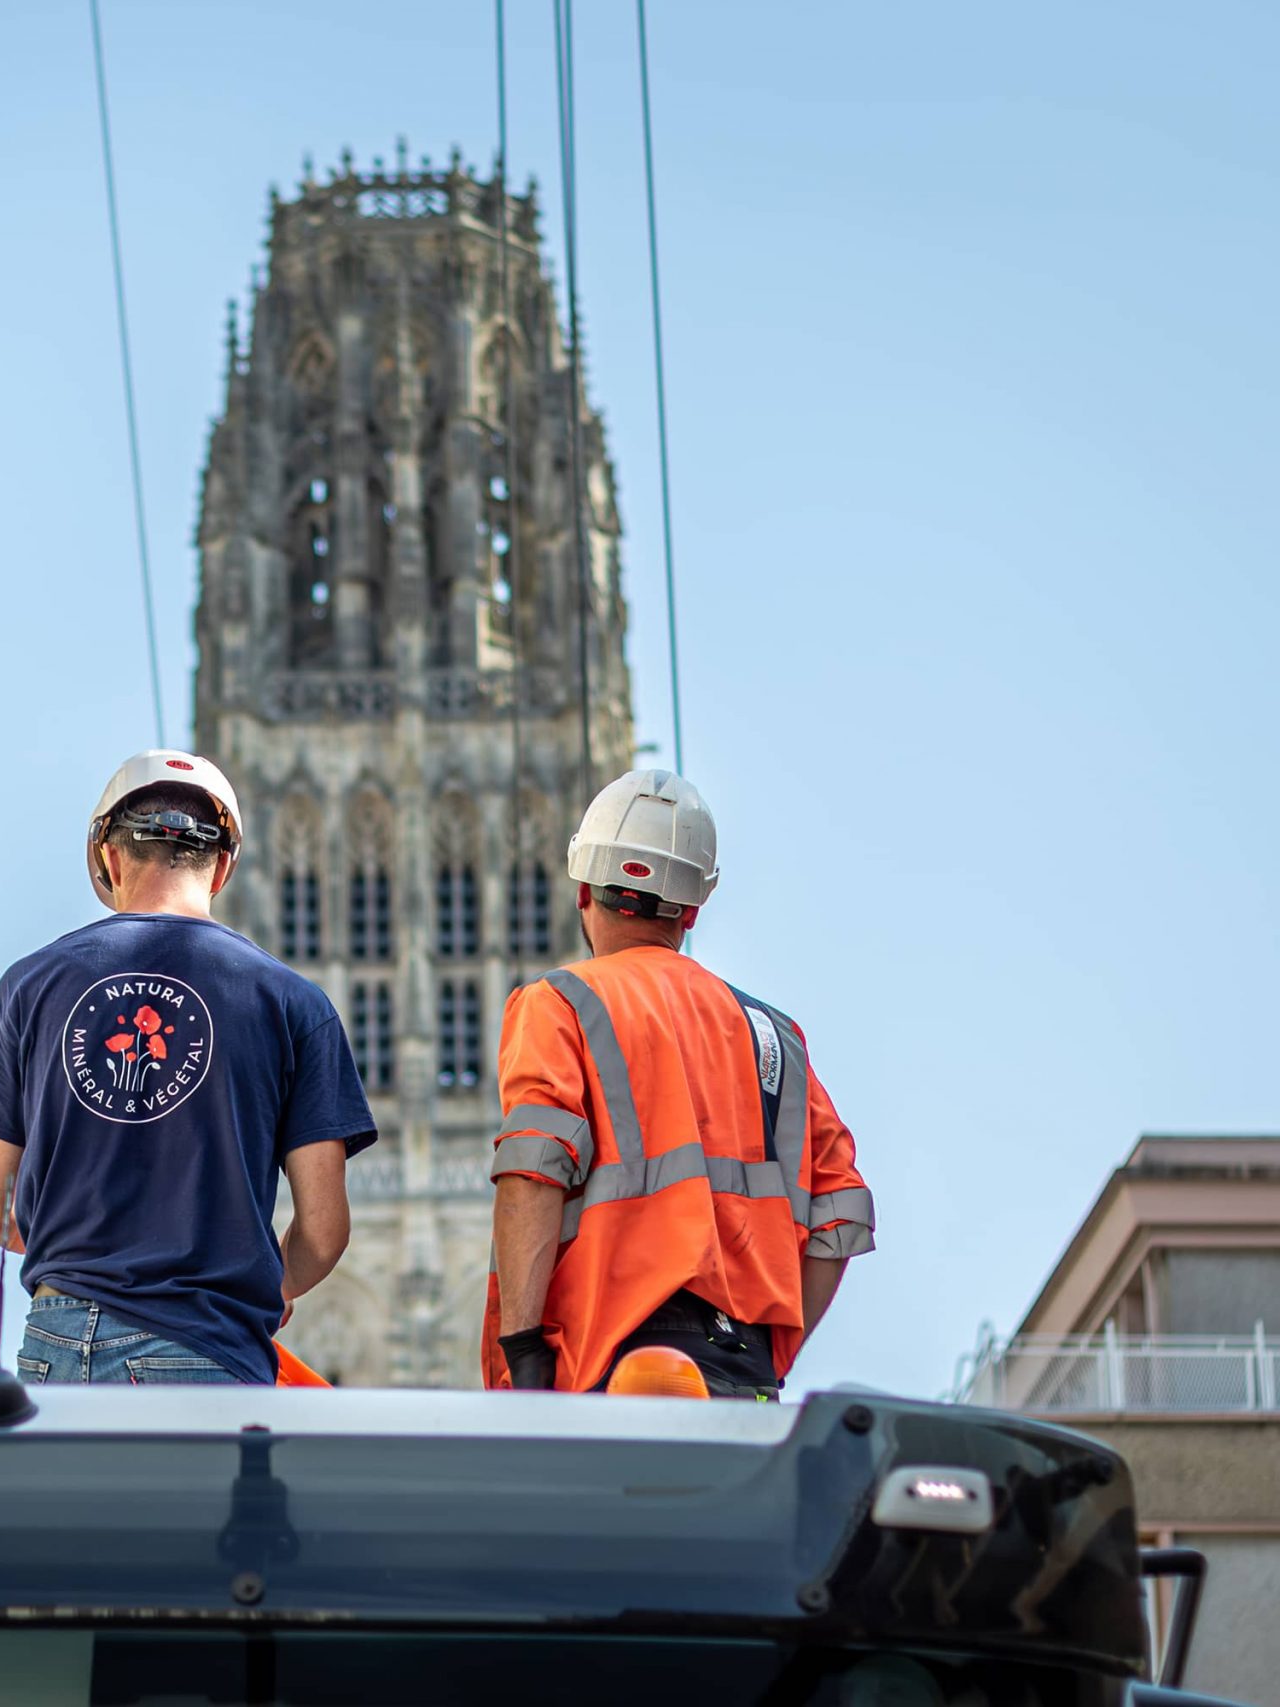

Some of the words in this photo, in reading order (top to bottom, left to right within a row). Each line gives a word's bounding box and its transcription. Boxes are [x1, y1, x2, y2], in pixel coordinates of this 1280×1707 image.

[105, 982, 185, 1008] NATURA
[72, 1028, 113, 1109] MINÉRAL
[125, 1099, 136, 1113] &
[143, 1037, 204, 1111] VÉGÉTAL
